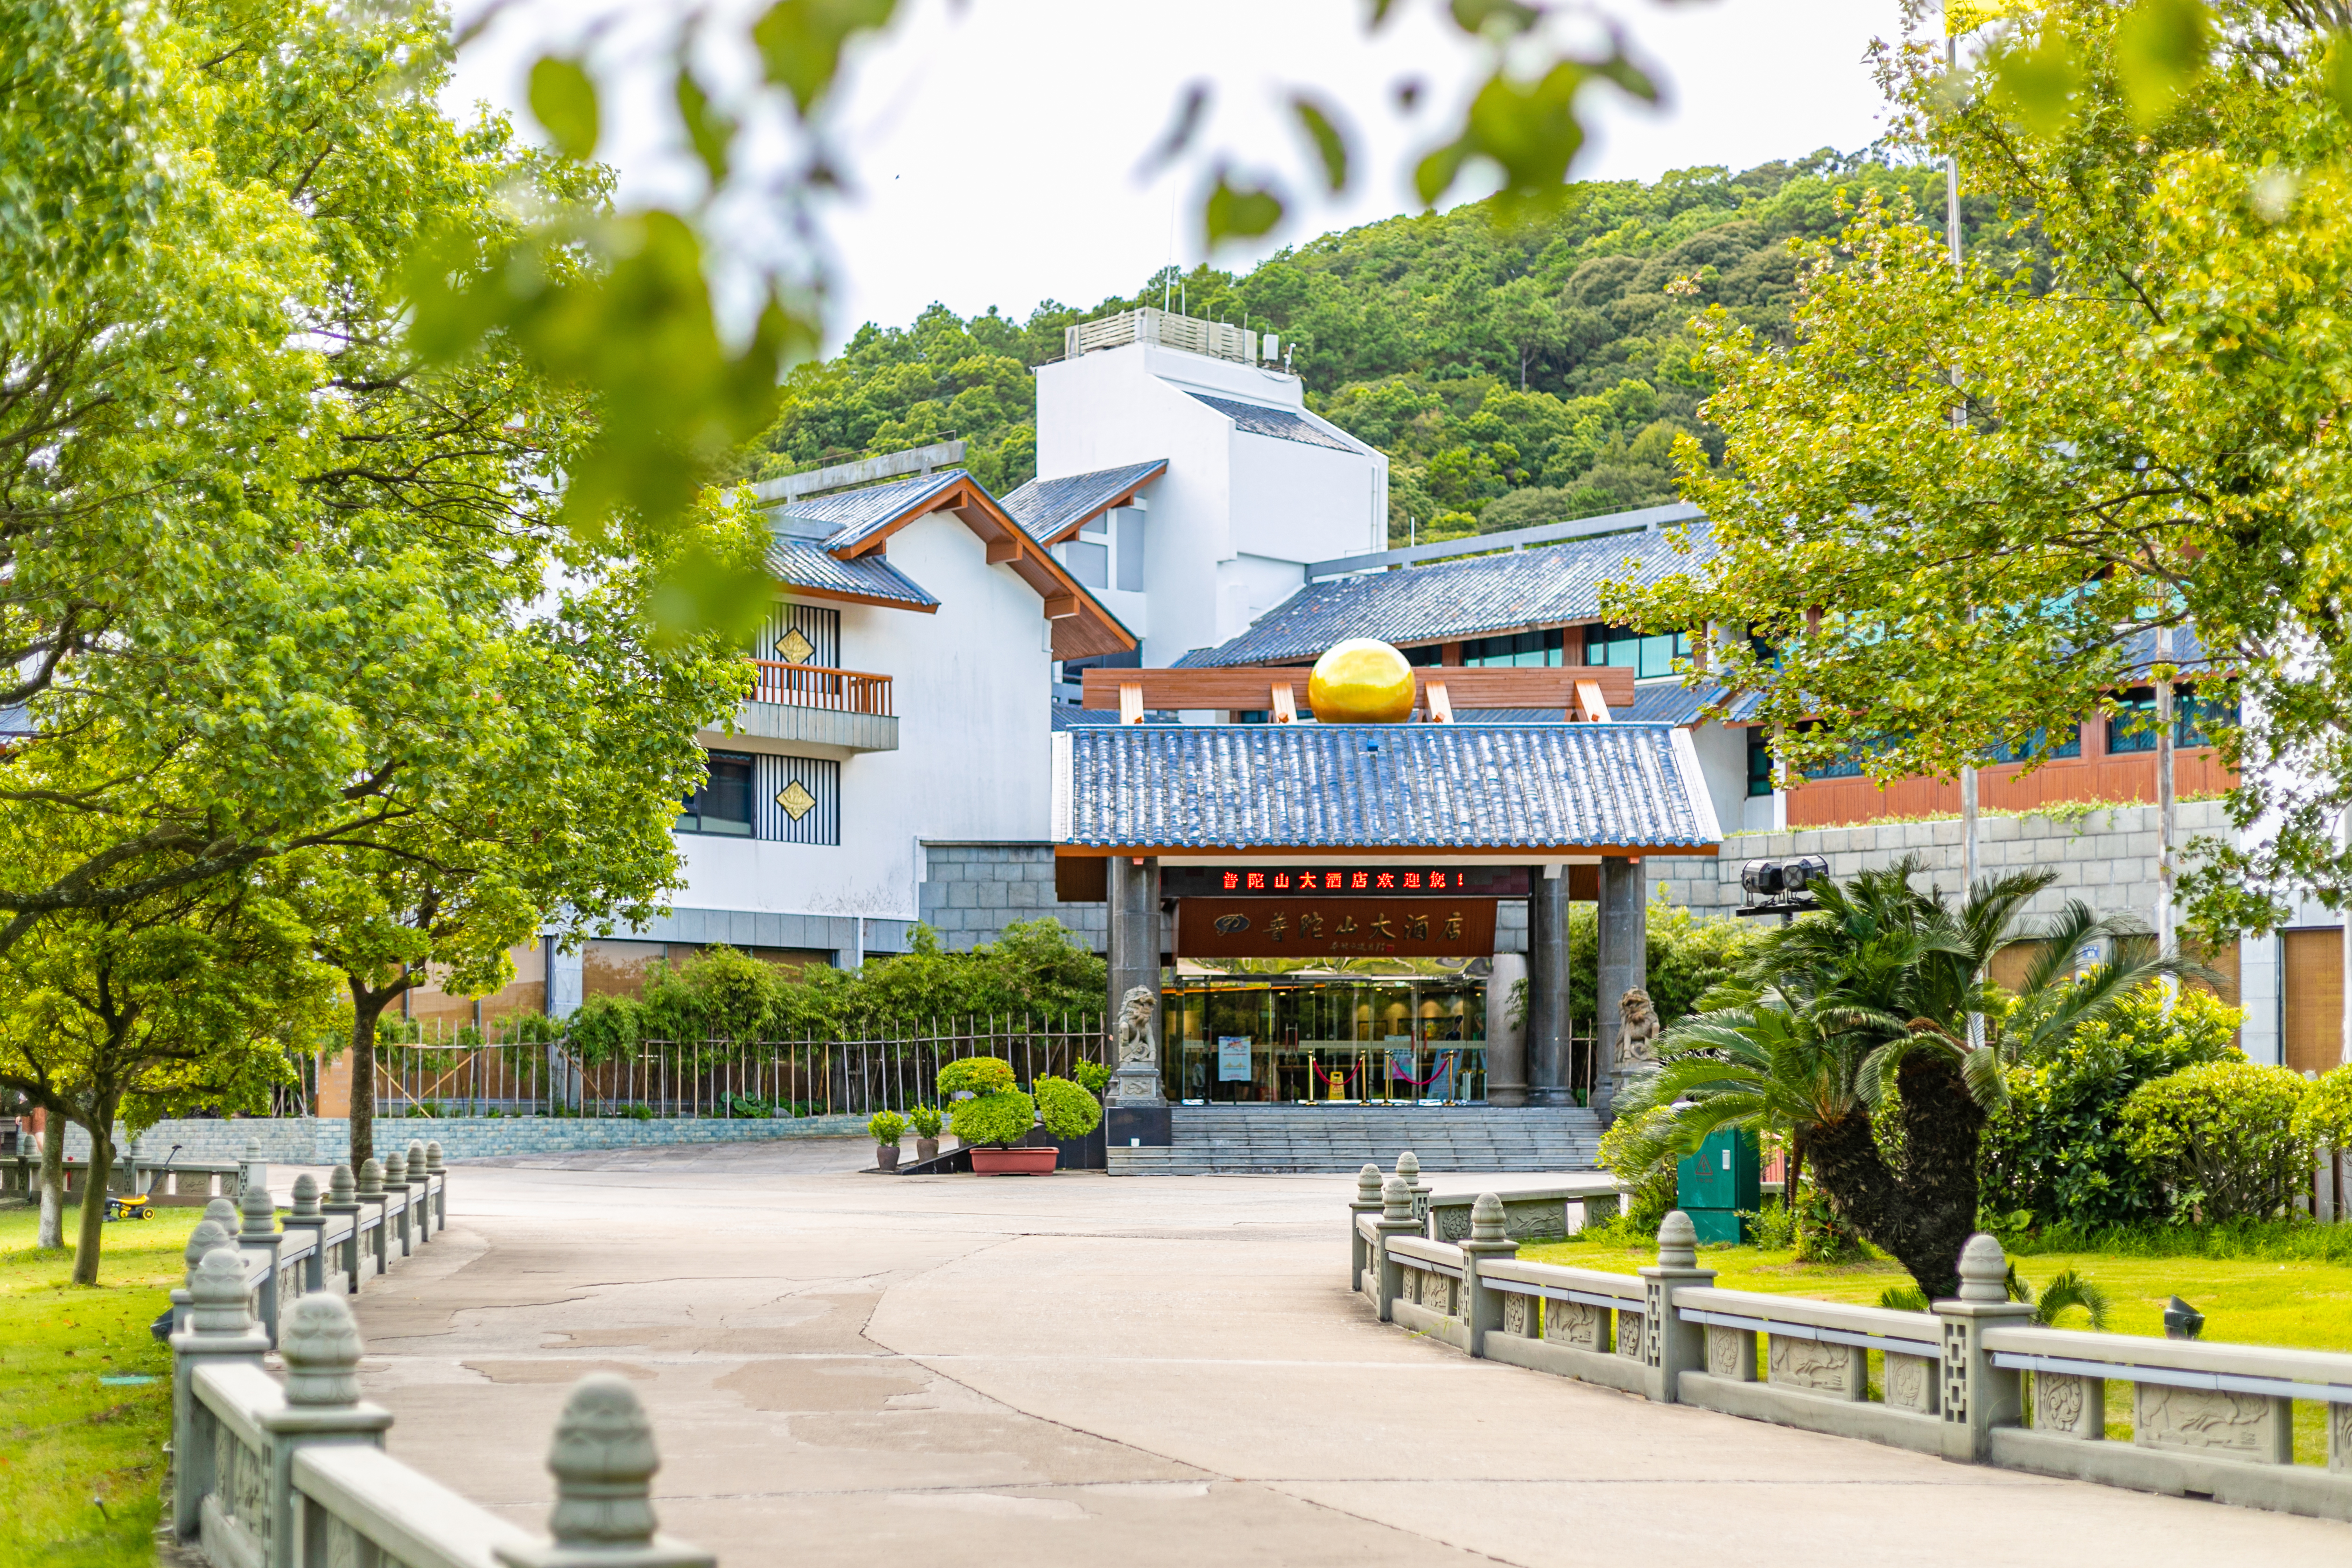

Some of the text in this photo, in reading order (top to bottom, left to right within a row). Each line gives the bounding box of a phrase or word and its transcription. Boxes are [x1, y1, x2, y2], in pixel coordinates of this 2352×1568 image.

[1262, 911, 1463, 943] 普陀山大酒店
